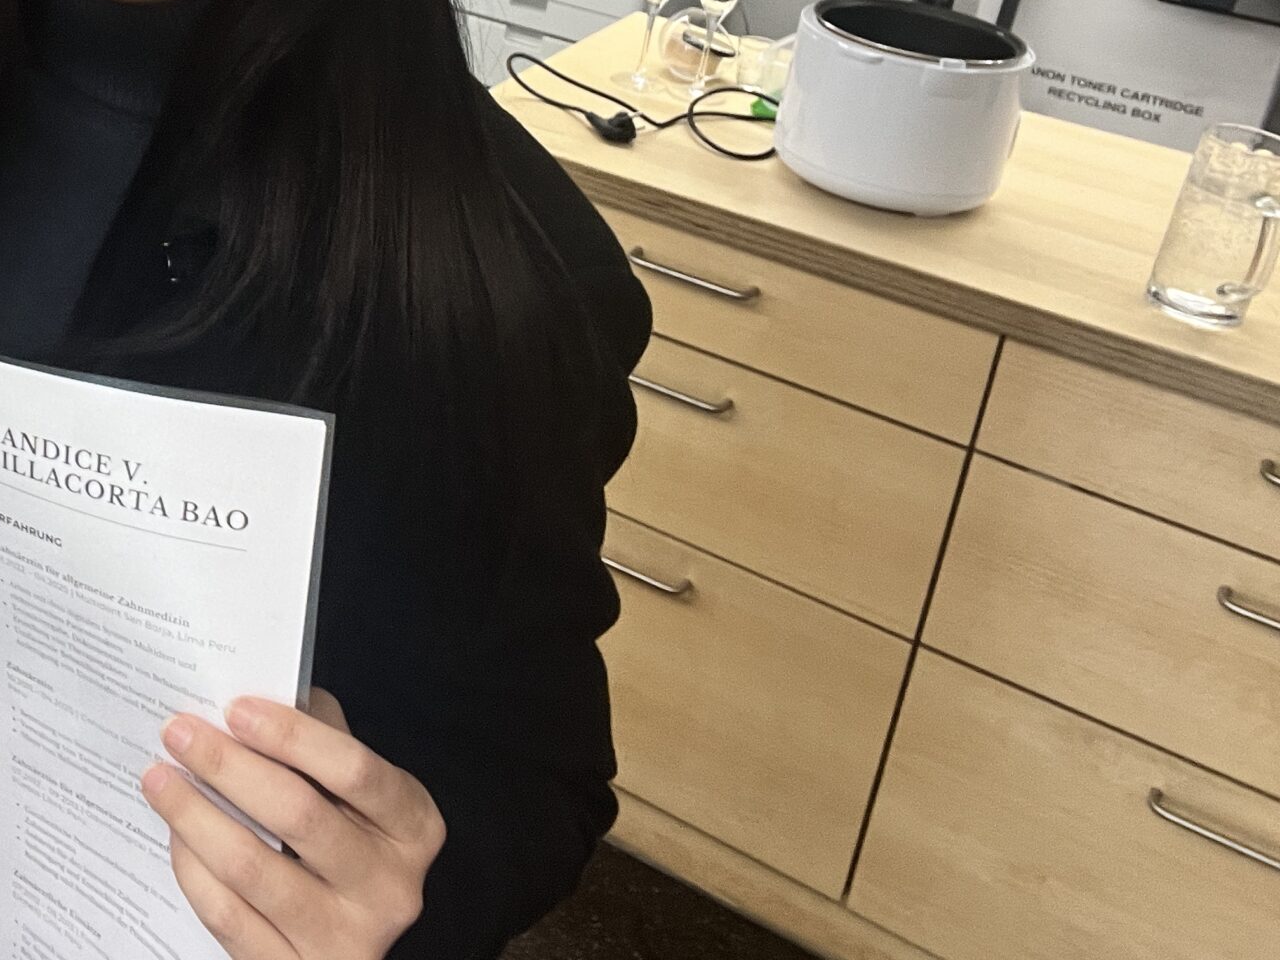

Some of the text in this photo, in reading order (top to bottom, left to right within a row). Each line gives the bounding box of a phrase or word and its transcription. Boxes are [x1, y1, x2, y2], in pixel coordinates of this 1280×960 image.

[1047, 86, 1162, 124] RECYCLING BOX
[1071, 74, 1117, 95] TONER
[1120, 88, 1205, 118] CARTRIDGE
[122, 459, 148, 485] V.
[180, 500, 249, 531] BAO
[62, 573, 115, 600] allgemeine
[117, 595, 190, 628] Zahnmedizin
[209, 640, 236, 654] Peru
